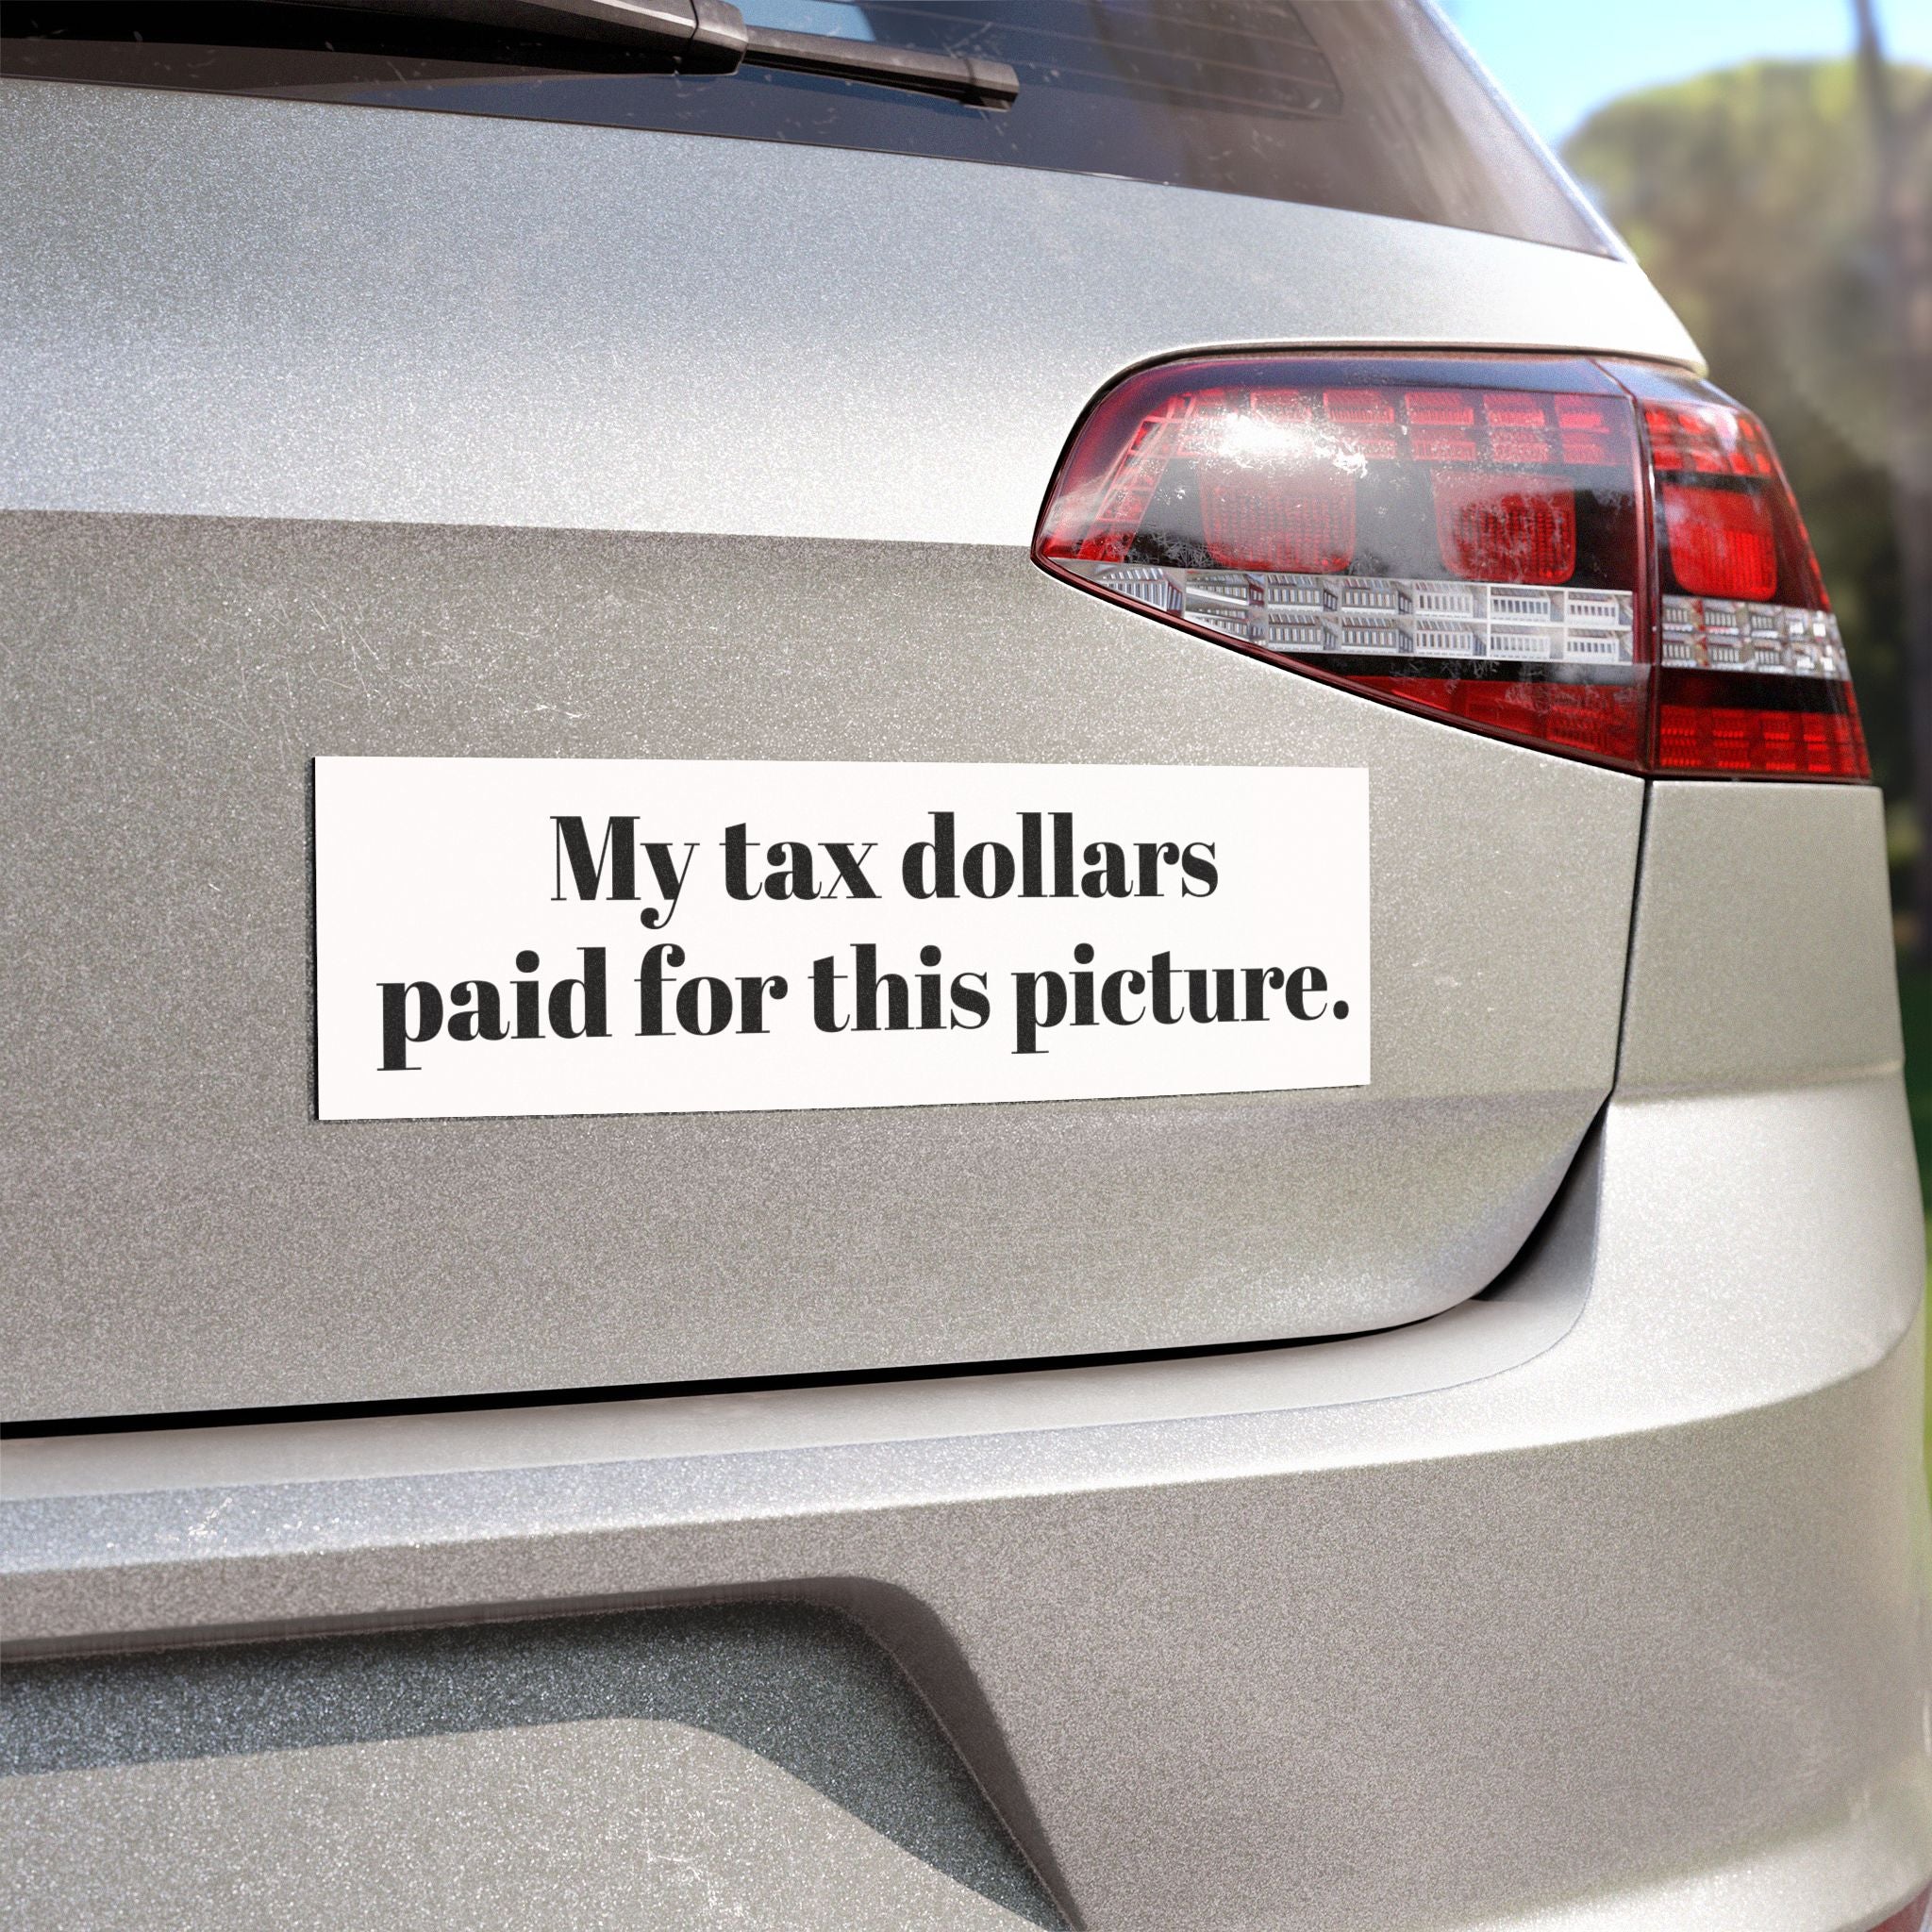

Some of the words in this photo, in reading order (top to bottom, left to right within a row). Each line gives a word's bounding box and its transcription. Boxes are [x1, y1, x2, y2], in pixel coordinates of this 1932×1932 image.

[550, 815, 700, 930] My
[718, 822, 883, 901] tax
[902, 811, 1219, 900] dollars
[375, 946, 613, 1072] paid
[633, 942, 789, 1037] for
[808, 942, 991, 1033] this
[1010, 942, 1350, 1055] picture.
